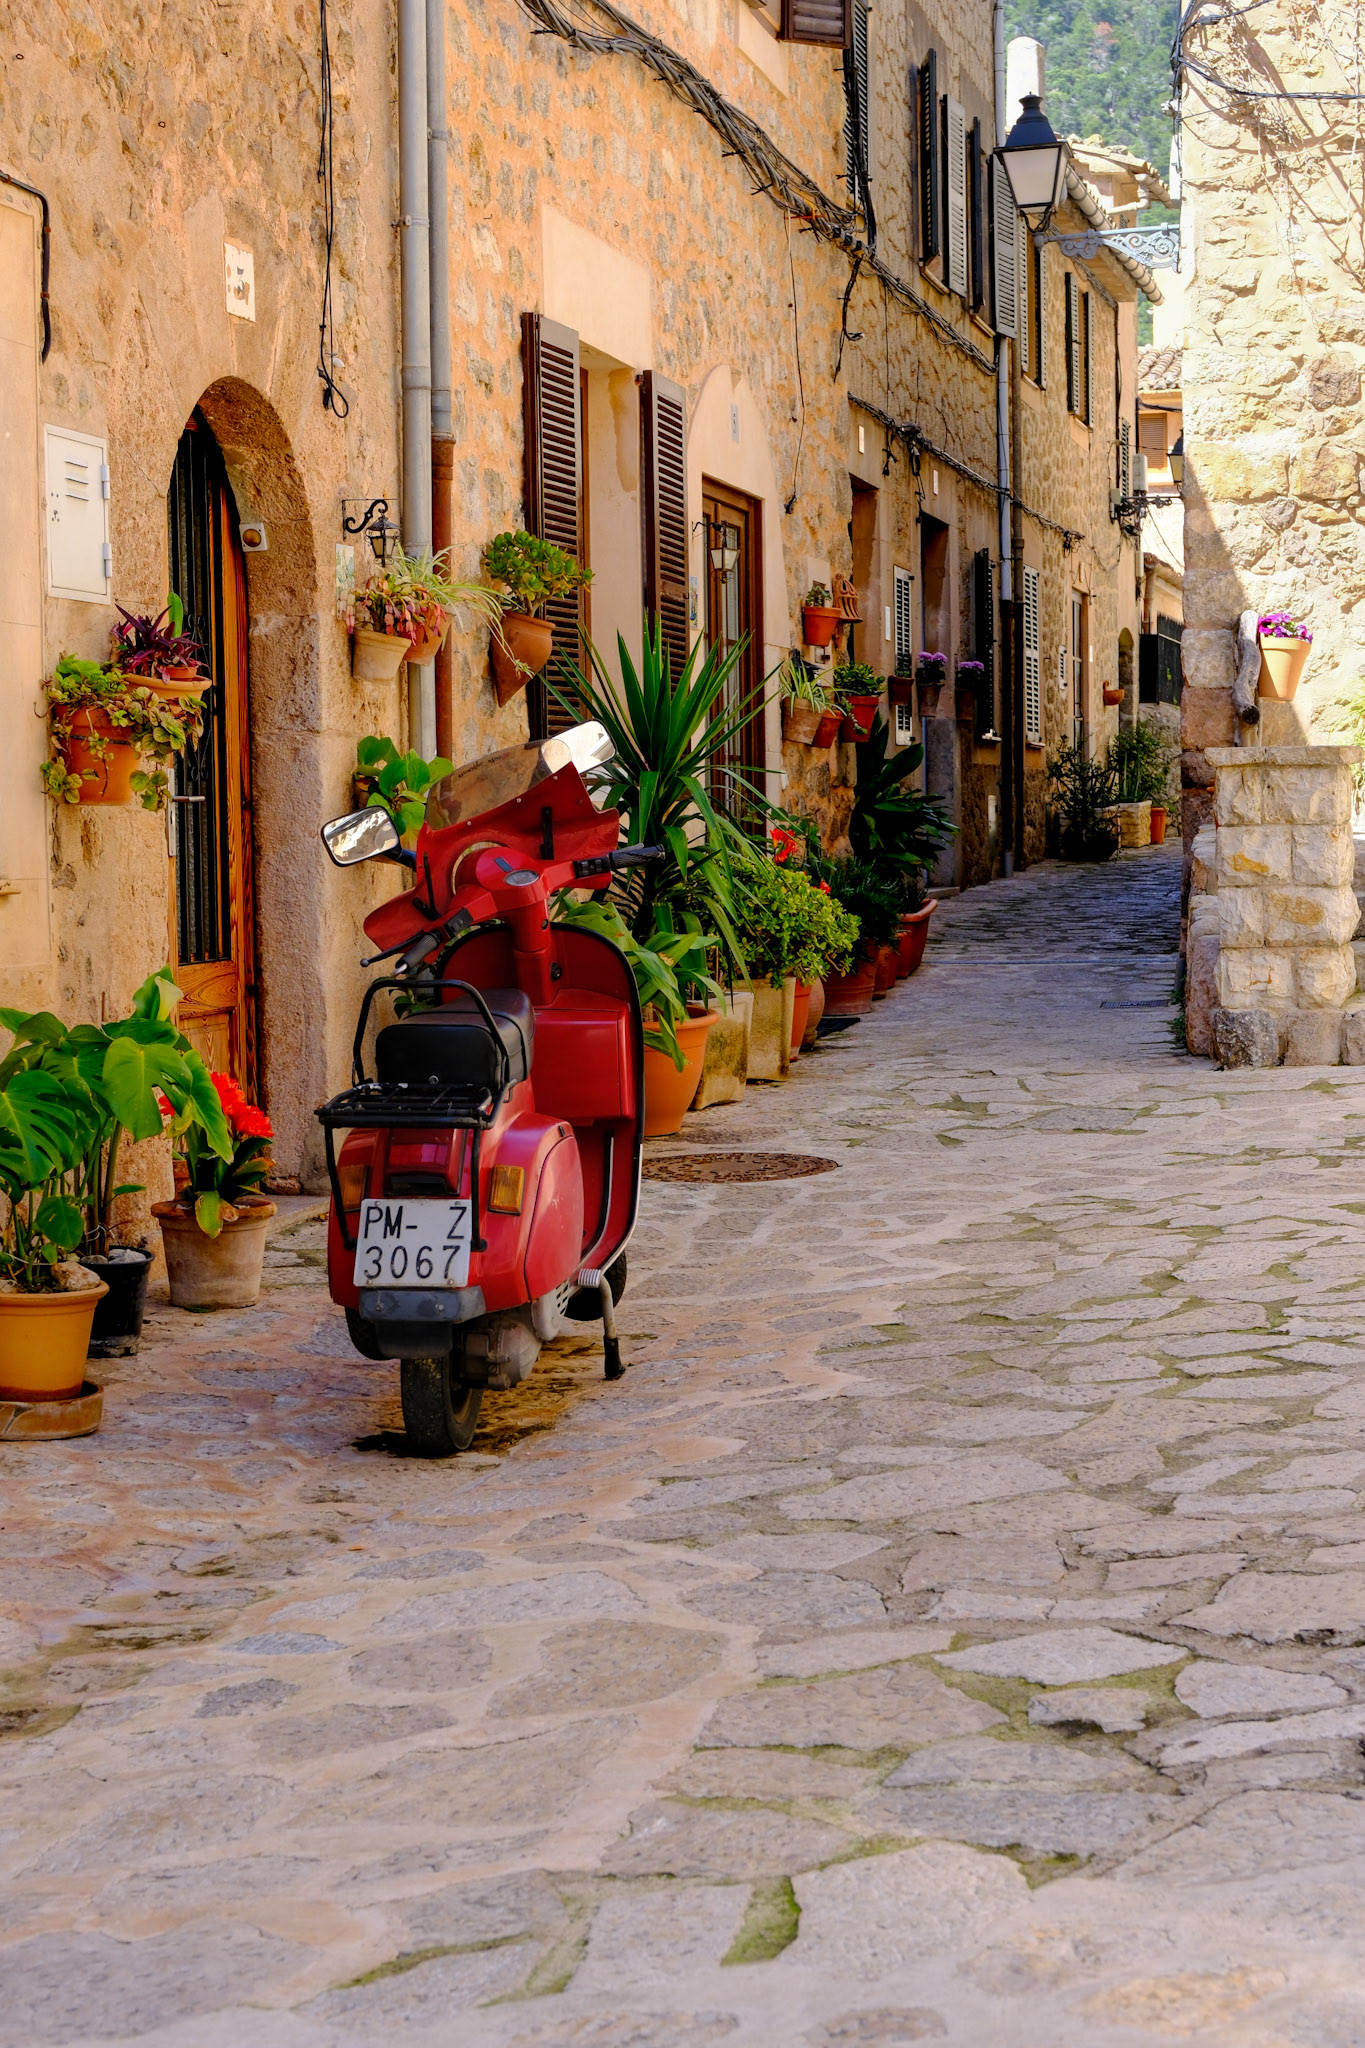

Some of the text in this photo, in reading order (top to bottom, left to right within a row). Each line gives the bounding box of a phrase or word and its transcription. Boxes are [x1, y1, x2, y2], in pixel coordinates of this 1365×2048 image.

[363, 1205, 468, 1240] PM- Z
[363, 1245, 462, 1280] 3067
